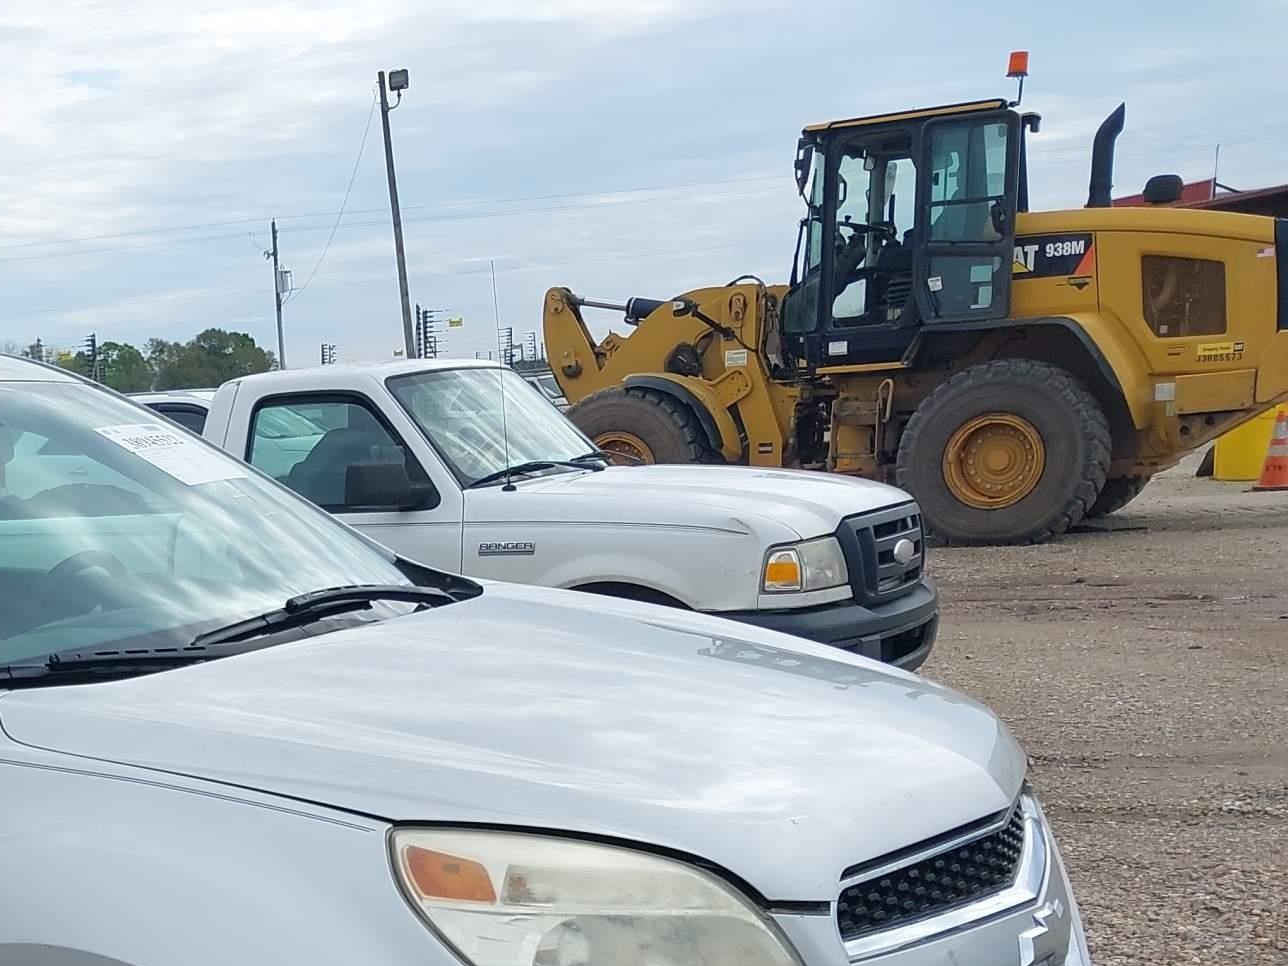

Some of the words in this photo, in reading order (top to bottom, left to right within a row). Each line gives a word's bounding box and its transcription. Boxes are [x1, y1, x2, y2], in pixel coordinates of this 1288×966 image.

[1013, 245, 1039, 272] AT
[1045, 240, 1085, 257] 938M
[479, 542, 533, 551] RANGER
